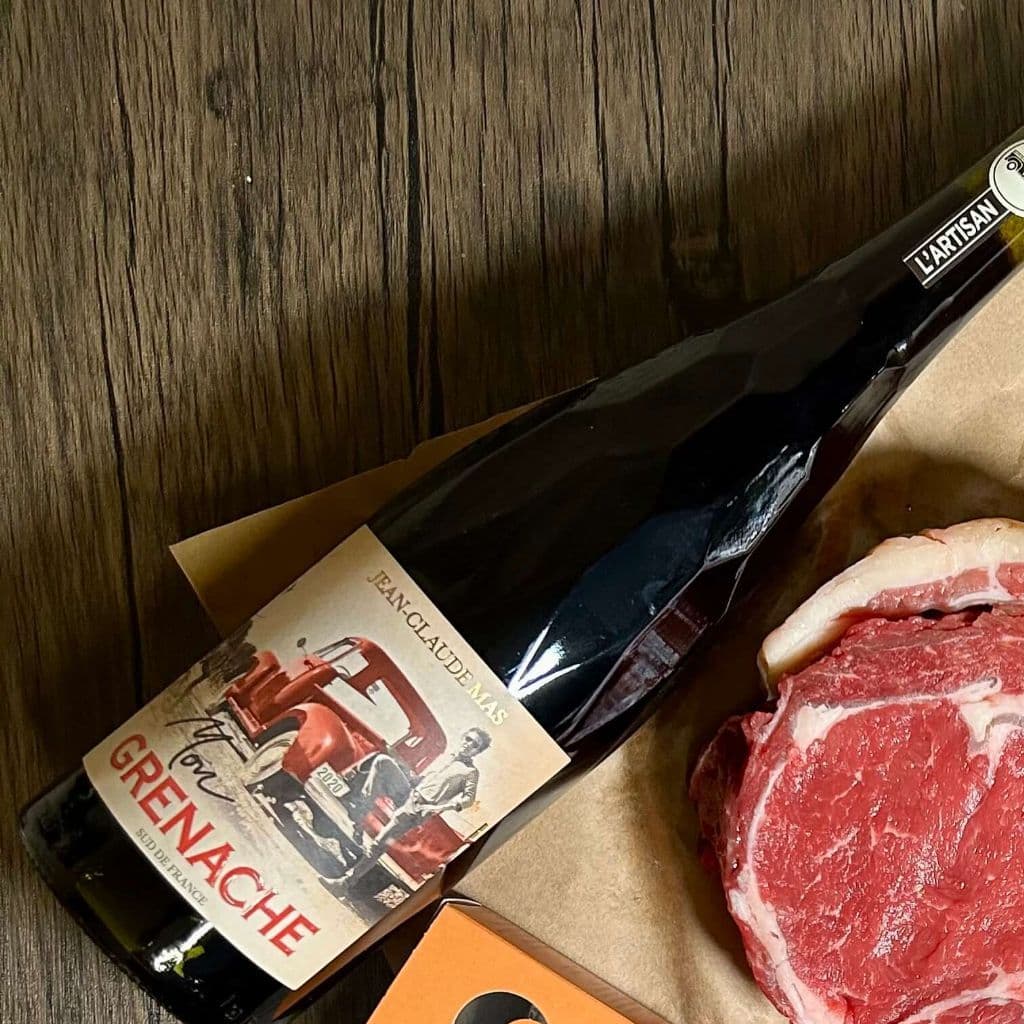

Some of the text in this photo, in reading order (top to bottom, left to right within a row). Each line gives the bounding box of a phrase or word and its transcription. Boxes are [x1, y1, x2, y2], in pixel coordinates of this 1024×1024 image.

[914, 198, 999, 275] L'ARTISAN
[367, 570, 509, 726] JEAN-CLAUDE MAS
[316, 767, 343, 793] 2020
[109, 733, 321, 957] GRENACHE
[136, 828, 208, 906] SUD DE FRANCE
